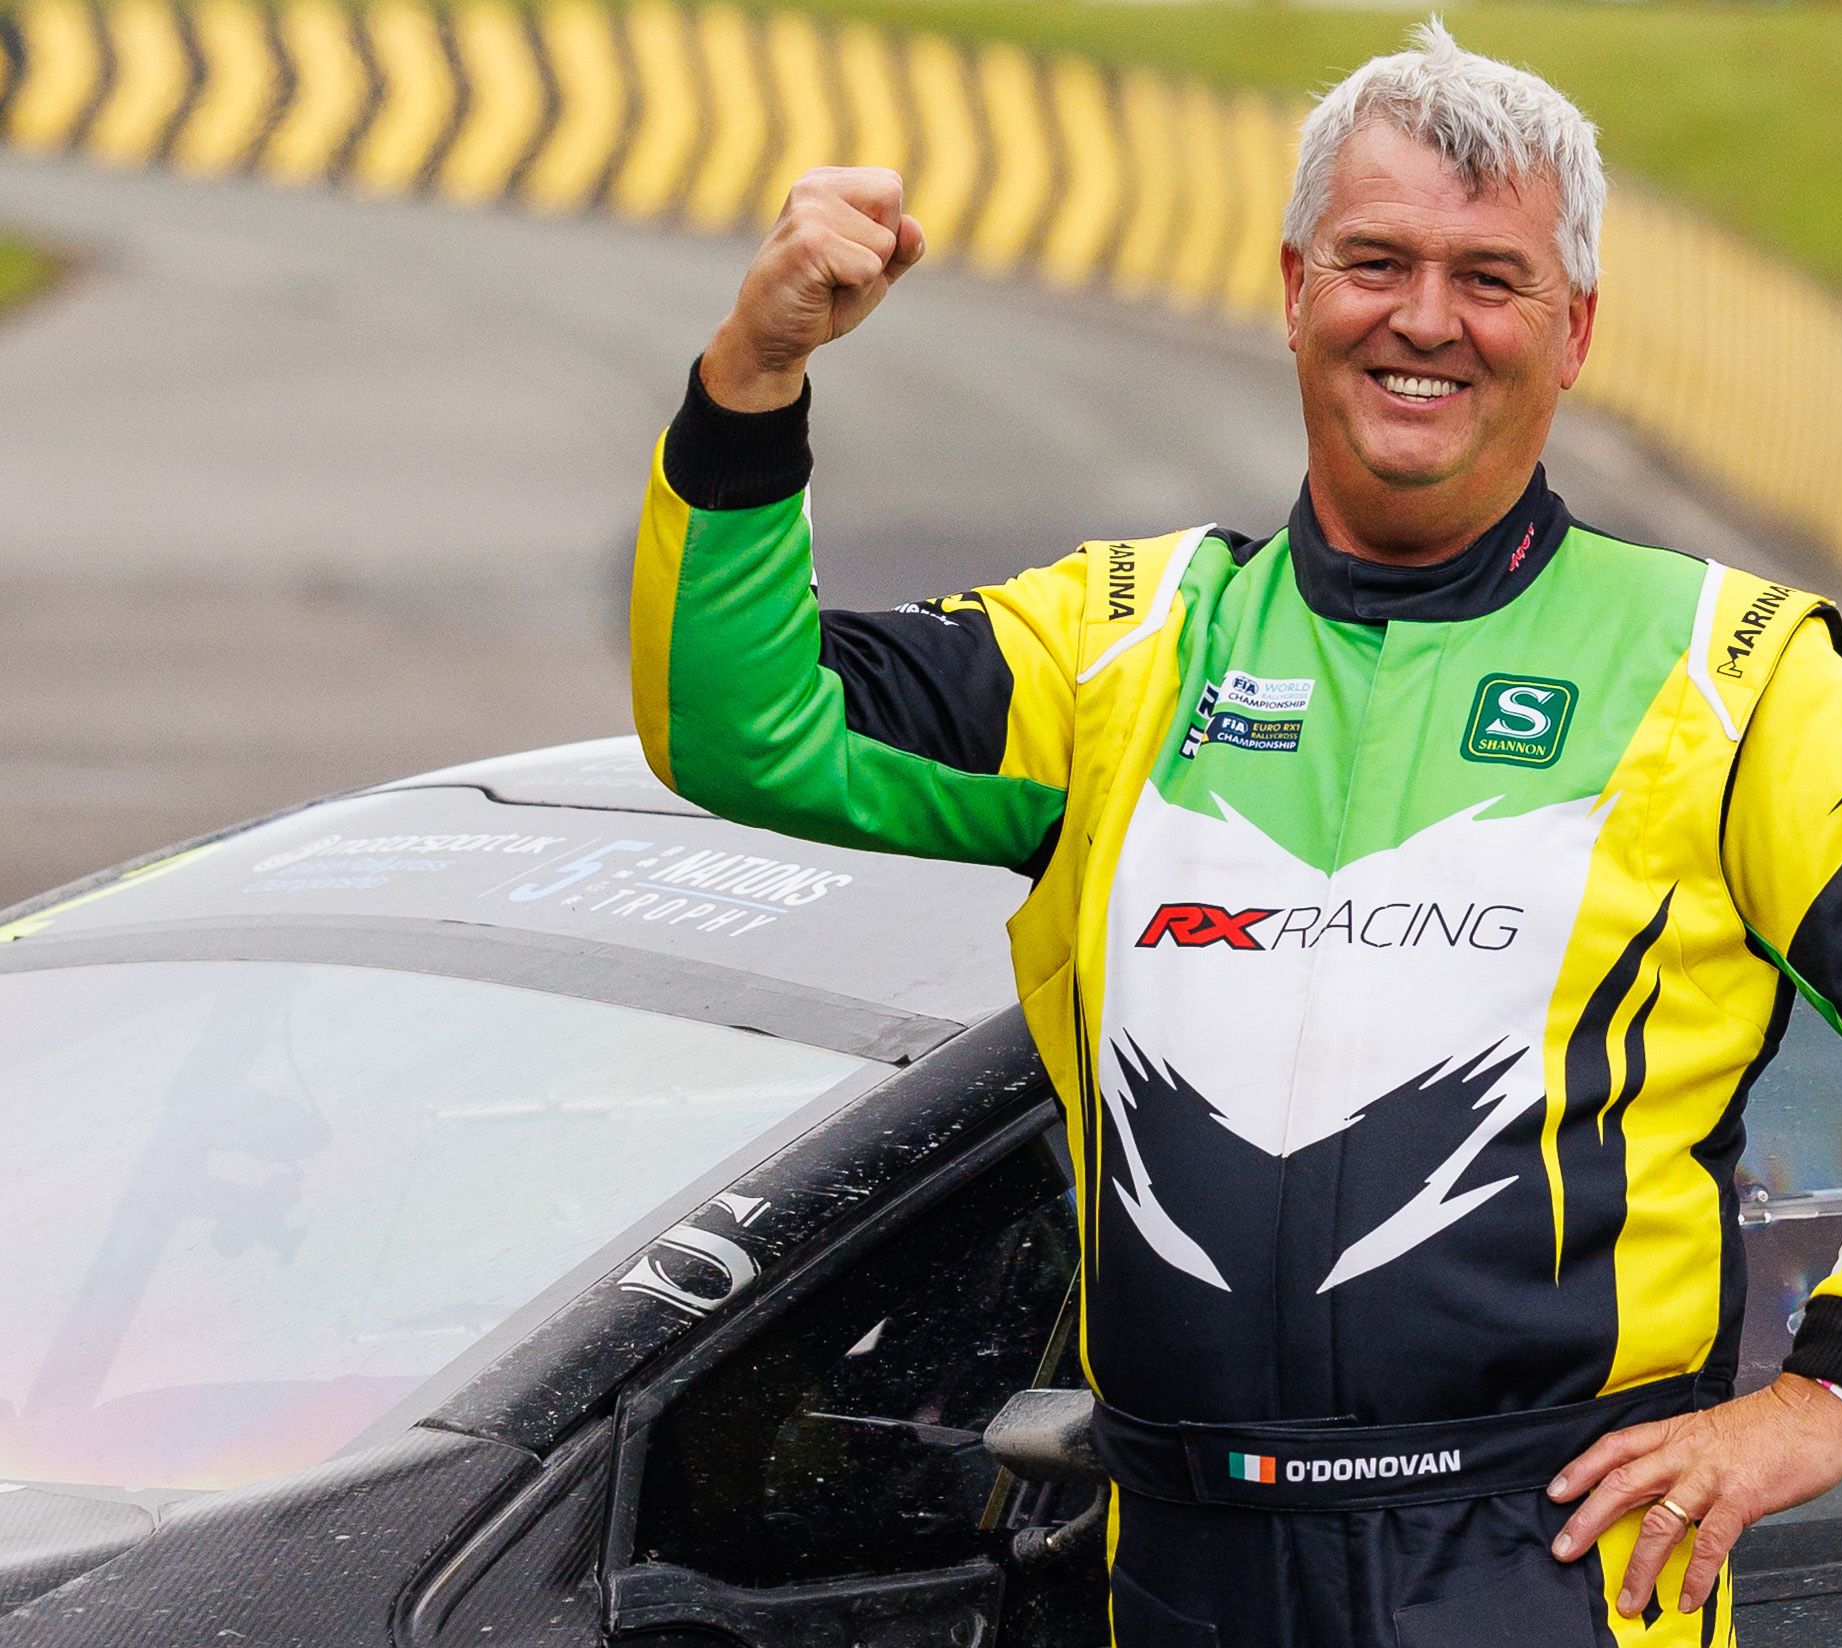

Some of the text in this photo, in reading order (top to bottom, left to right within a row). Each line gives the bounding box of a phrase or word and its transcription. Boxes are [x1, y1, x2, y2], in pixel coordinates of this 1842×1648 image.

[1716, 585, 1797, 679] MARINA
[1233, 677, 1311, 697] FIA WORLD
[1228, 692, 1307, 709] CHAMPIONSHIP
[1222, 718, 1246, 732] FIA
[1252, 723, 1282, 731] EURO
[1217, 732, 1297, 749] CHAMPIONSHIP
[1250, 731, 1298, 739] RALLYCROSS
[1478, 739, 1547, 756] SHANNON
[649, 849, 853, 906] NATIONS
[590, 888, 777, 937] TROPHY
[1285, 1449, 1461, 1482] O'DONOVAN
